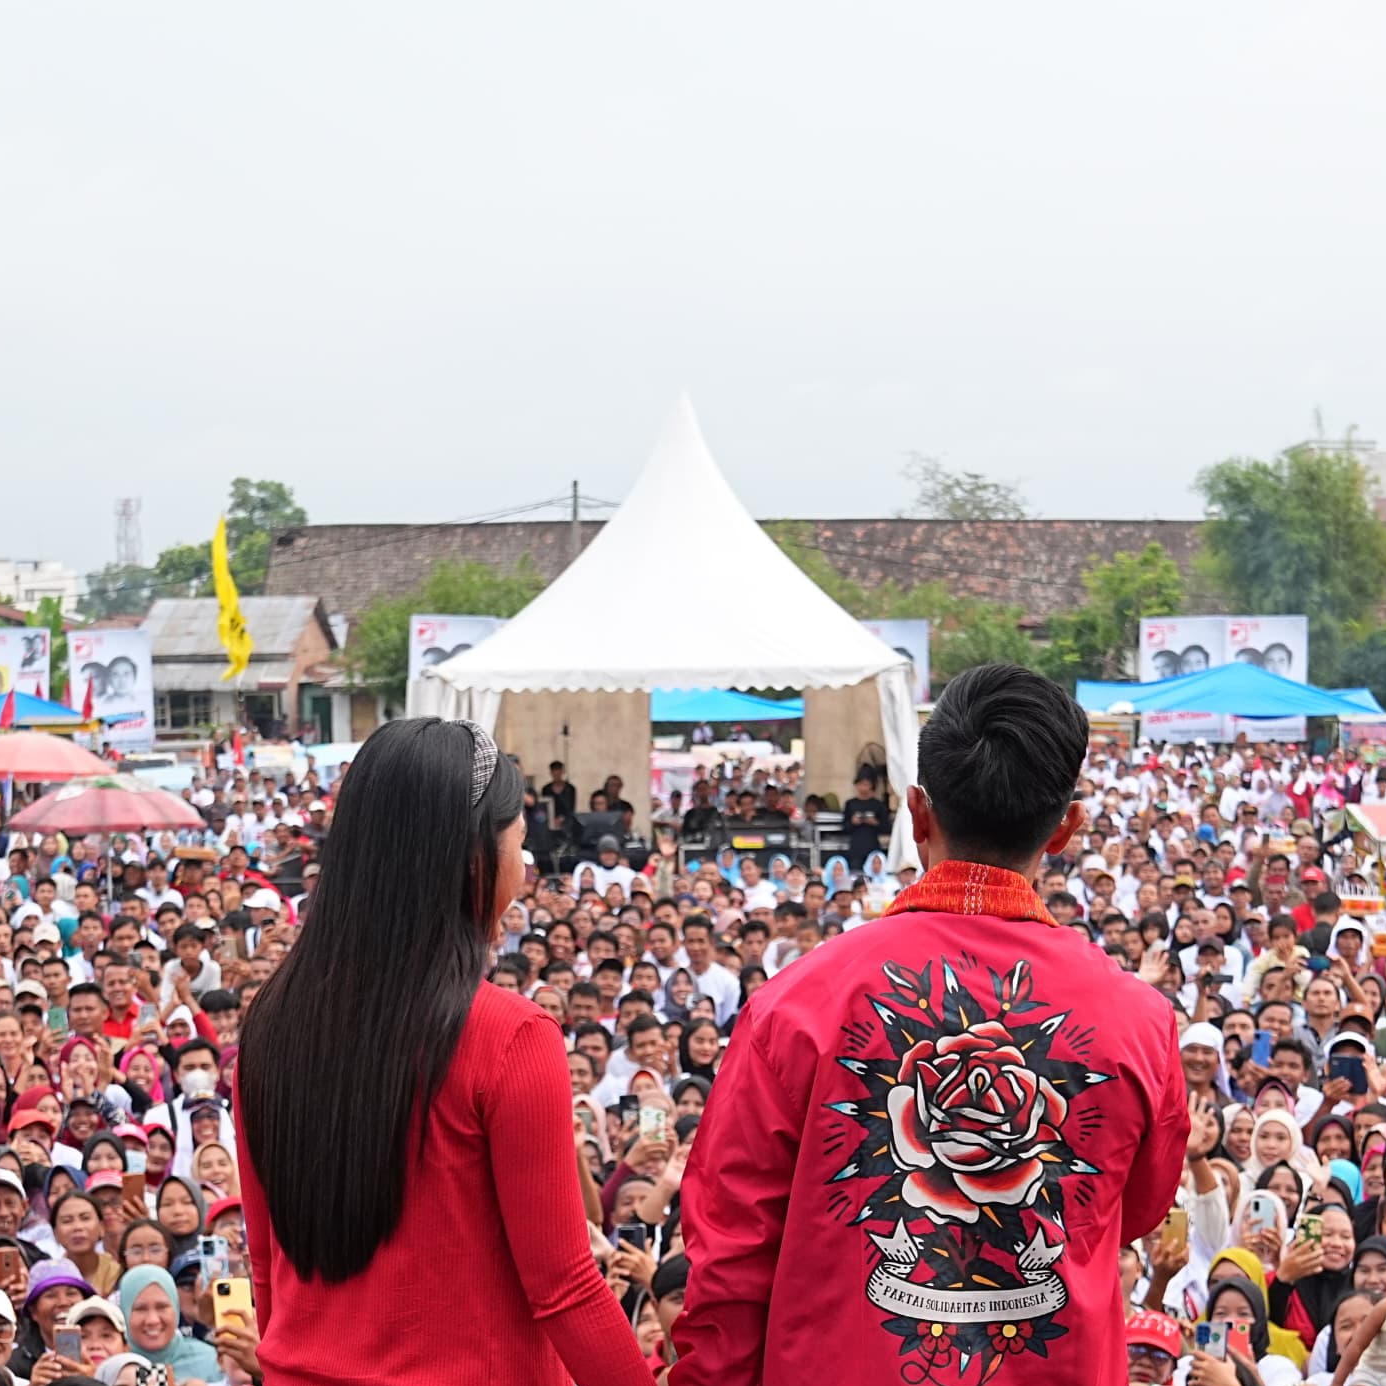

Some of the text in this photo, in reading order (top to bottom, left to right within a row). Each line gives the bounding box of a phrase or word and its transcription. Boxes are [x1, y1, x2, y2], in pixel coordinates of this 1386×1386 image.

[883, 1285, 1049, 1314] PARTAI SOLIDARITAS INDONESIA
